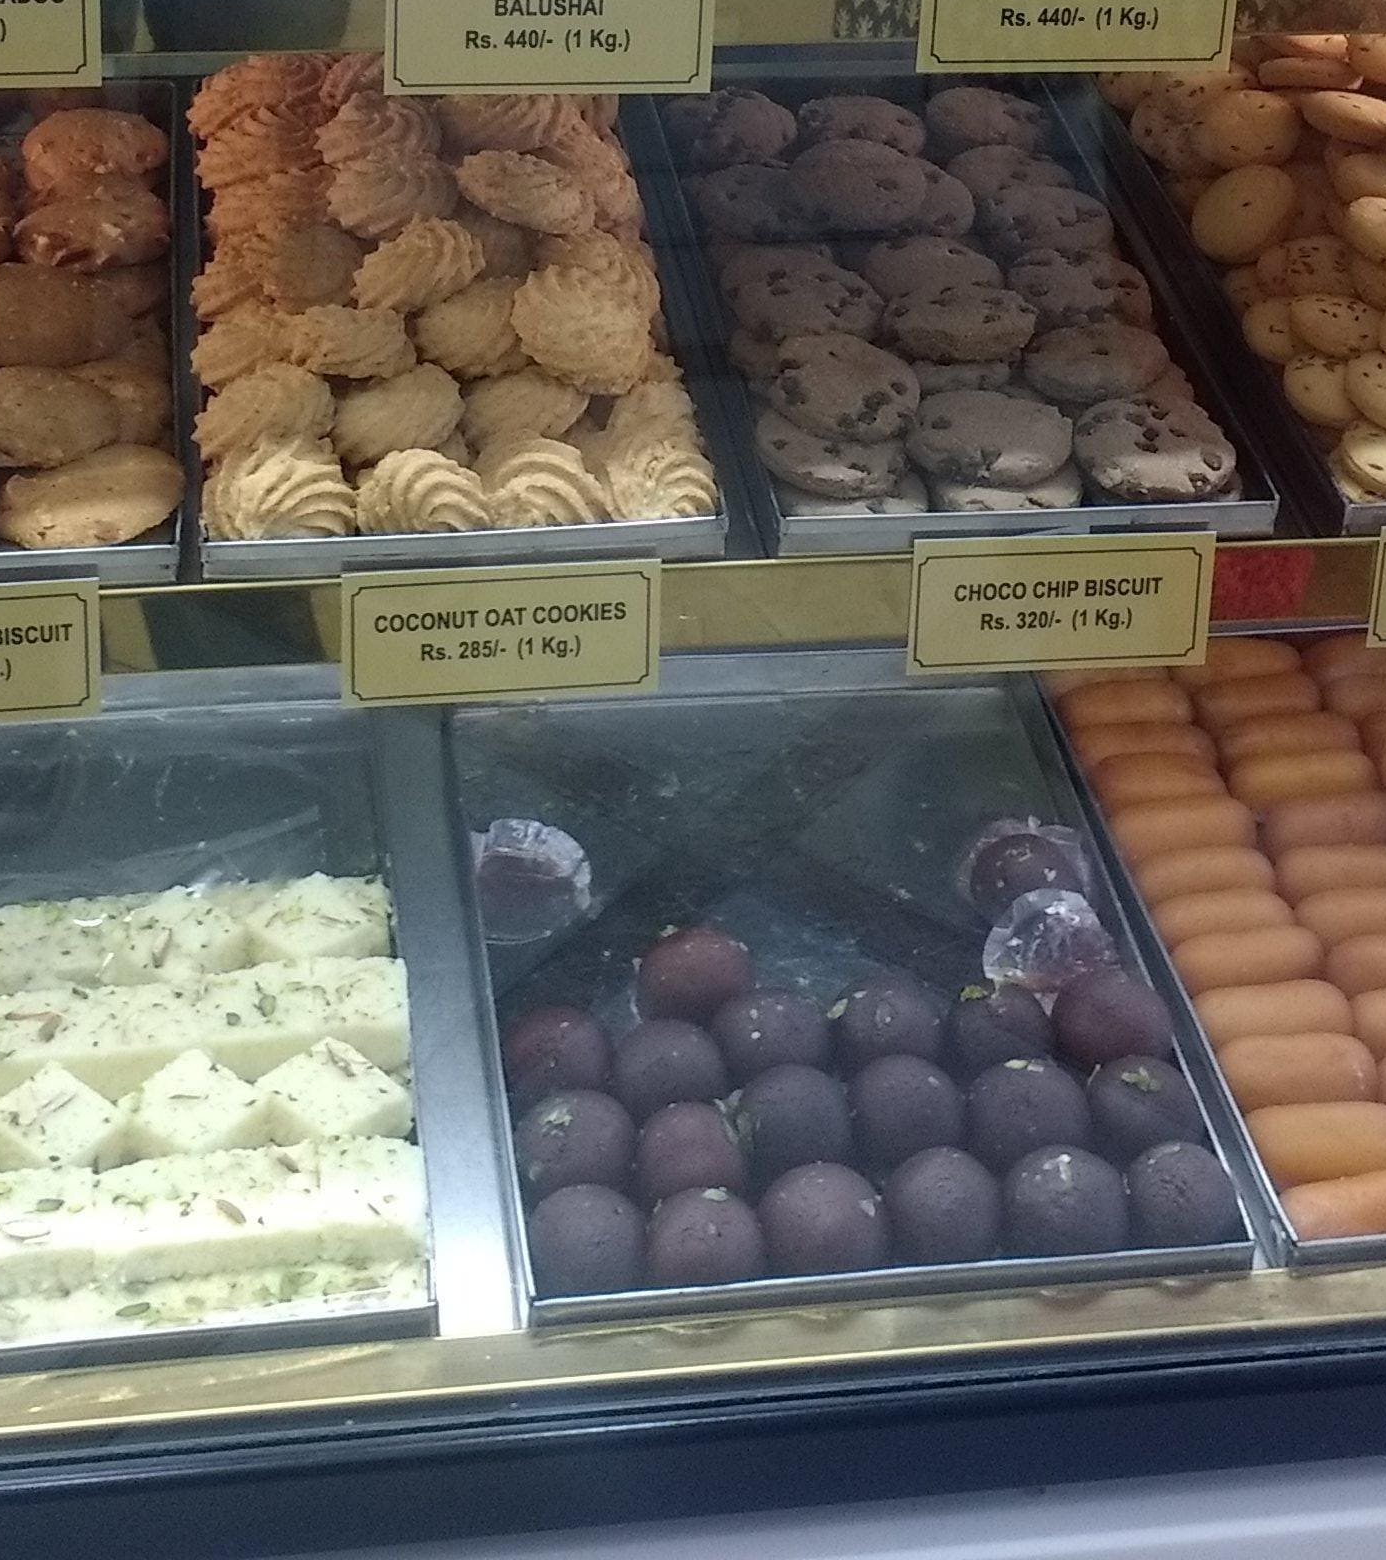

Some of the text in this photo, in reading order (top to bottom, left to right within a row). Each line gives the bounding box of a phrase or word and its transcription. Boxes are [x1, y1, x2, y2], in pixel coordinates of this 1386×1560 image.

[1001, 8, 1158, 30] Rs. 440/- (1 Kg.)
[466, 29, 630, 52] Rs. 440/- (1 Kg.)
[954, 577, 1163, 602] CHOCO CHIP BISCUIT
[374, 601, 627, 633] COCONUT OAT COOKIES
[981, 608, 1133, 631] Rs. 320/- (1 Kg.)
[421, 635, 581, 661] Rs. 285/- (1 Kg.)
